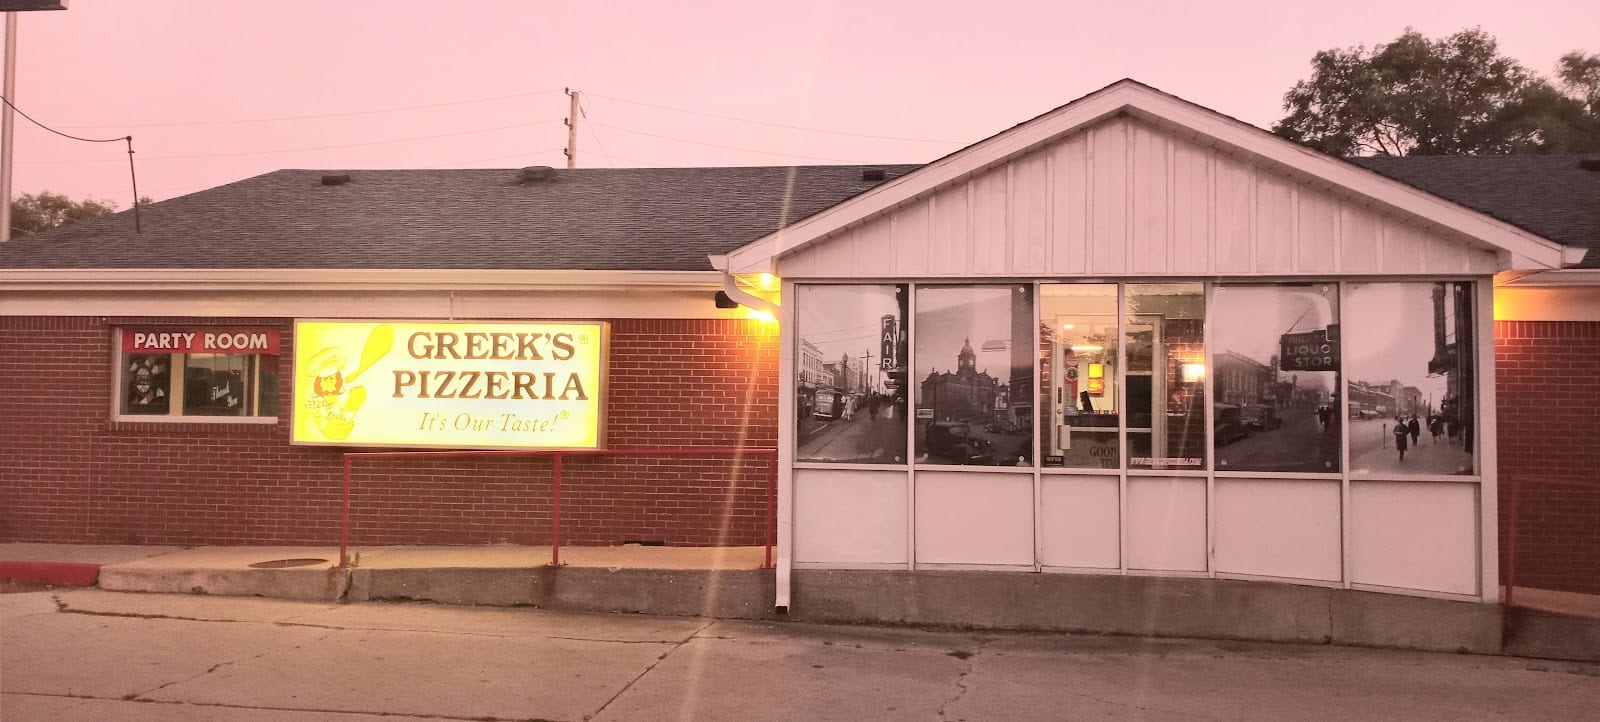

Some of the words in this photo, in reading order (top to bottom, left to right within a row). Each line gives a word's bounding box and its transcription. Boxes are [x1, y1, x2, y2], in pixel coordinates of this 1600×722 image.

[134, 332, 195, 349] PARTY
[204, 333, 268, 349] ROOM
[407, 331, 575, 361] GREEK'S
[882, 318, 893, 370] FAIR
[391, 370, 589, 400] PIZZERIA
[418, 412, 447, 431] It's
[453, 412, 494, 432] Our
[500, 412, 559, 432] Taste!
[1089, 446, 1117, 458] GOOD
